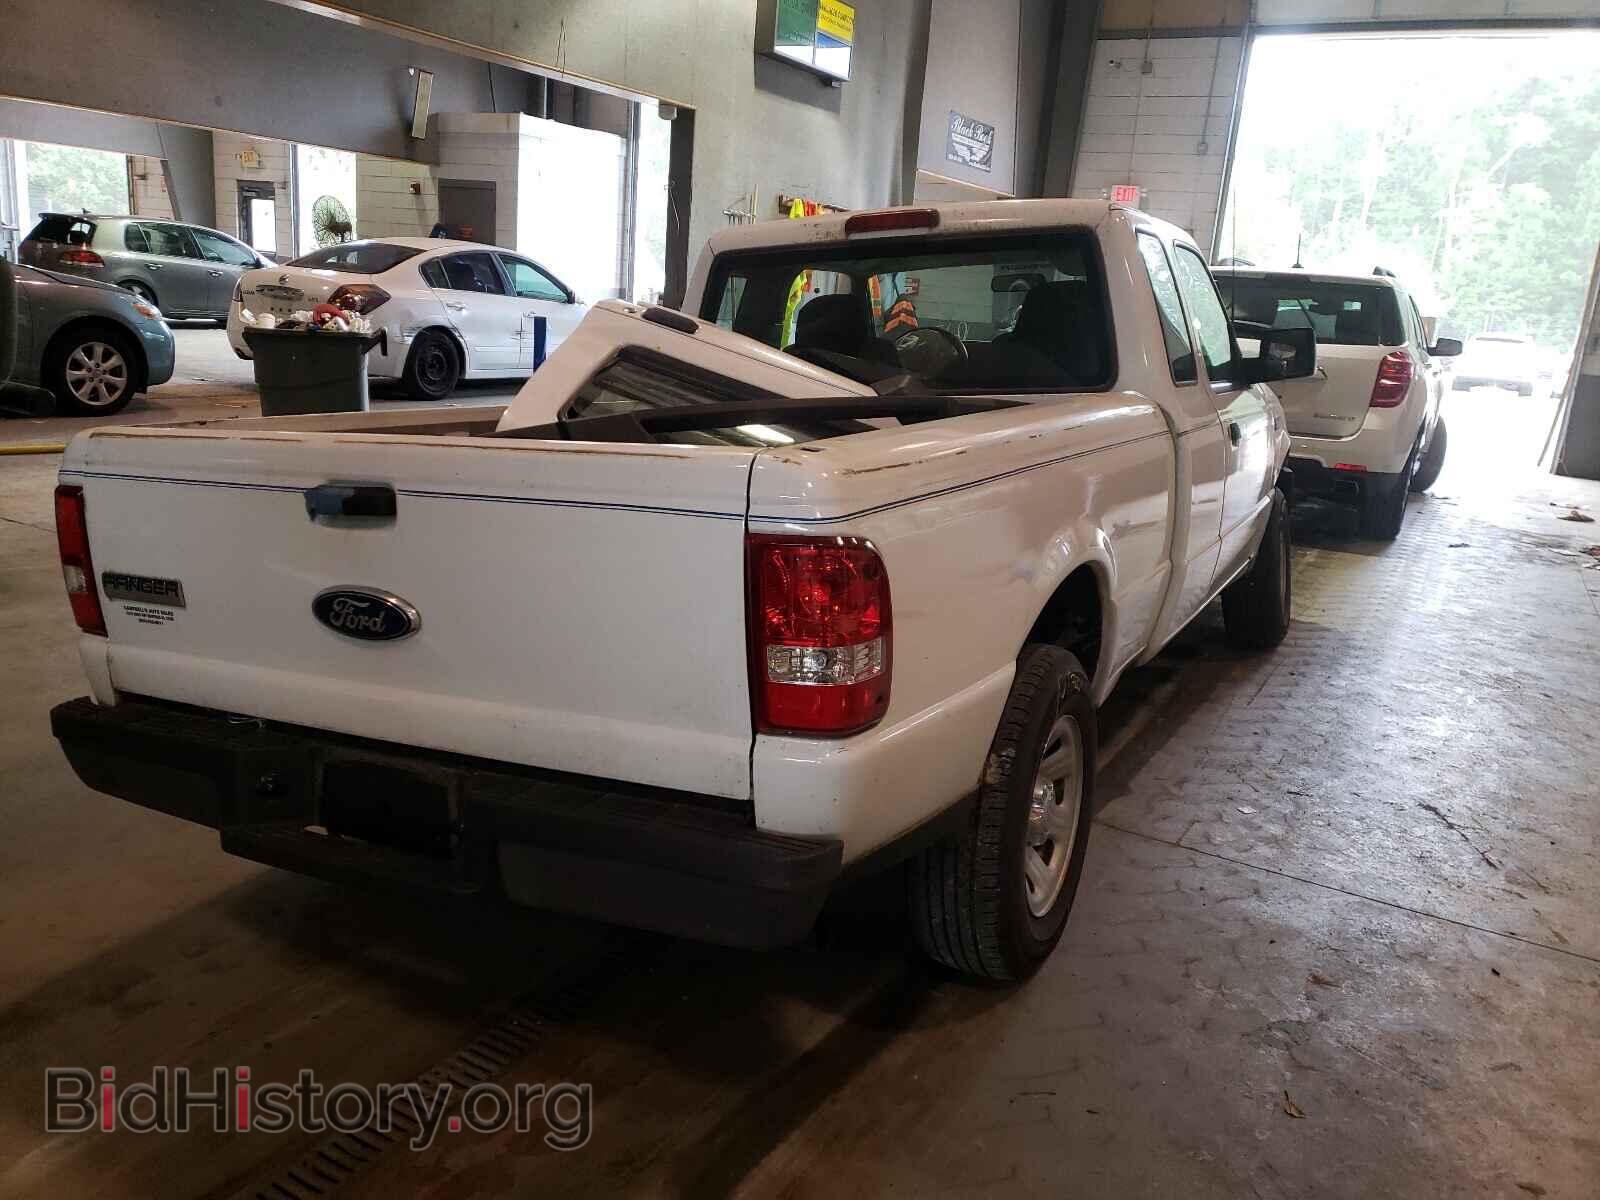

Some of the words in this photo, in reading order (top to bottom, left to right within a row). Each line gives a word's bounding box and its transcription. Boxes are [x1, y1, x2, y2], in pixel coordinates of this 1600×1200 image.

[951, 115, 974, 138] Black
[1116, 186, 1136, 202] EXIT
[102, 573, 180, 597] RANGER
[329, 597, 386, 632] Ford
